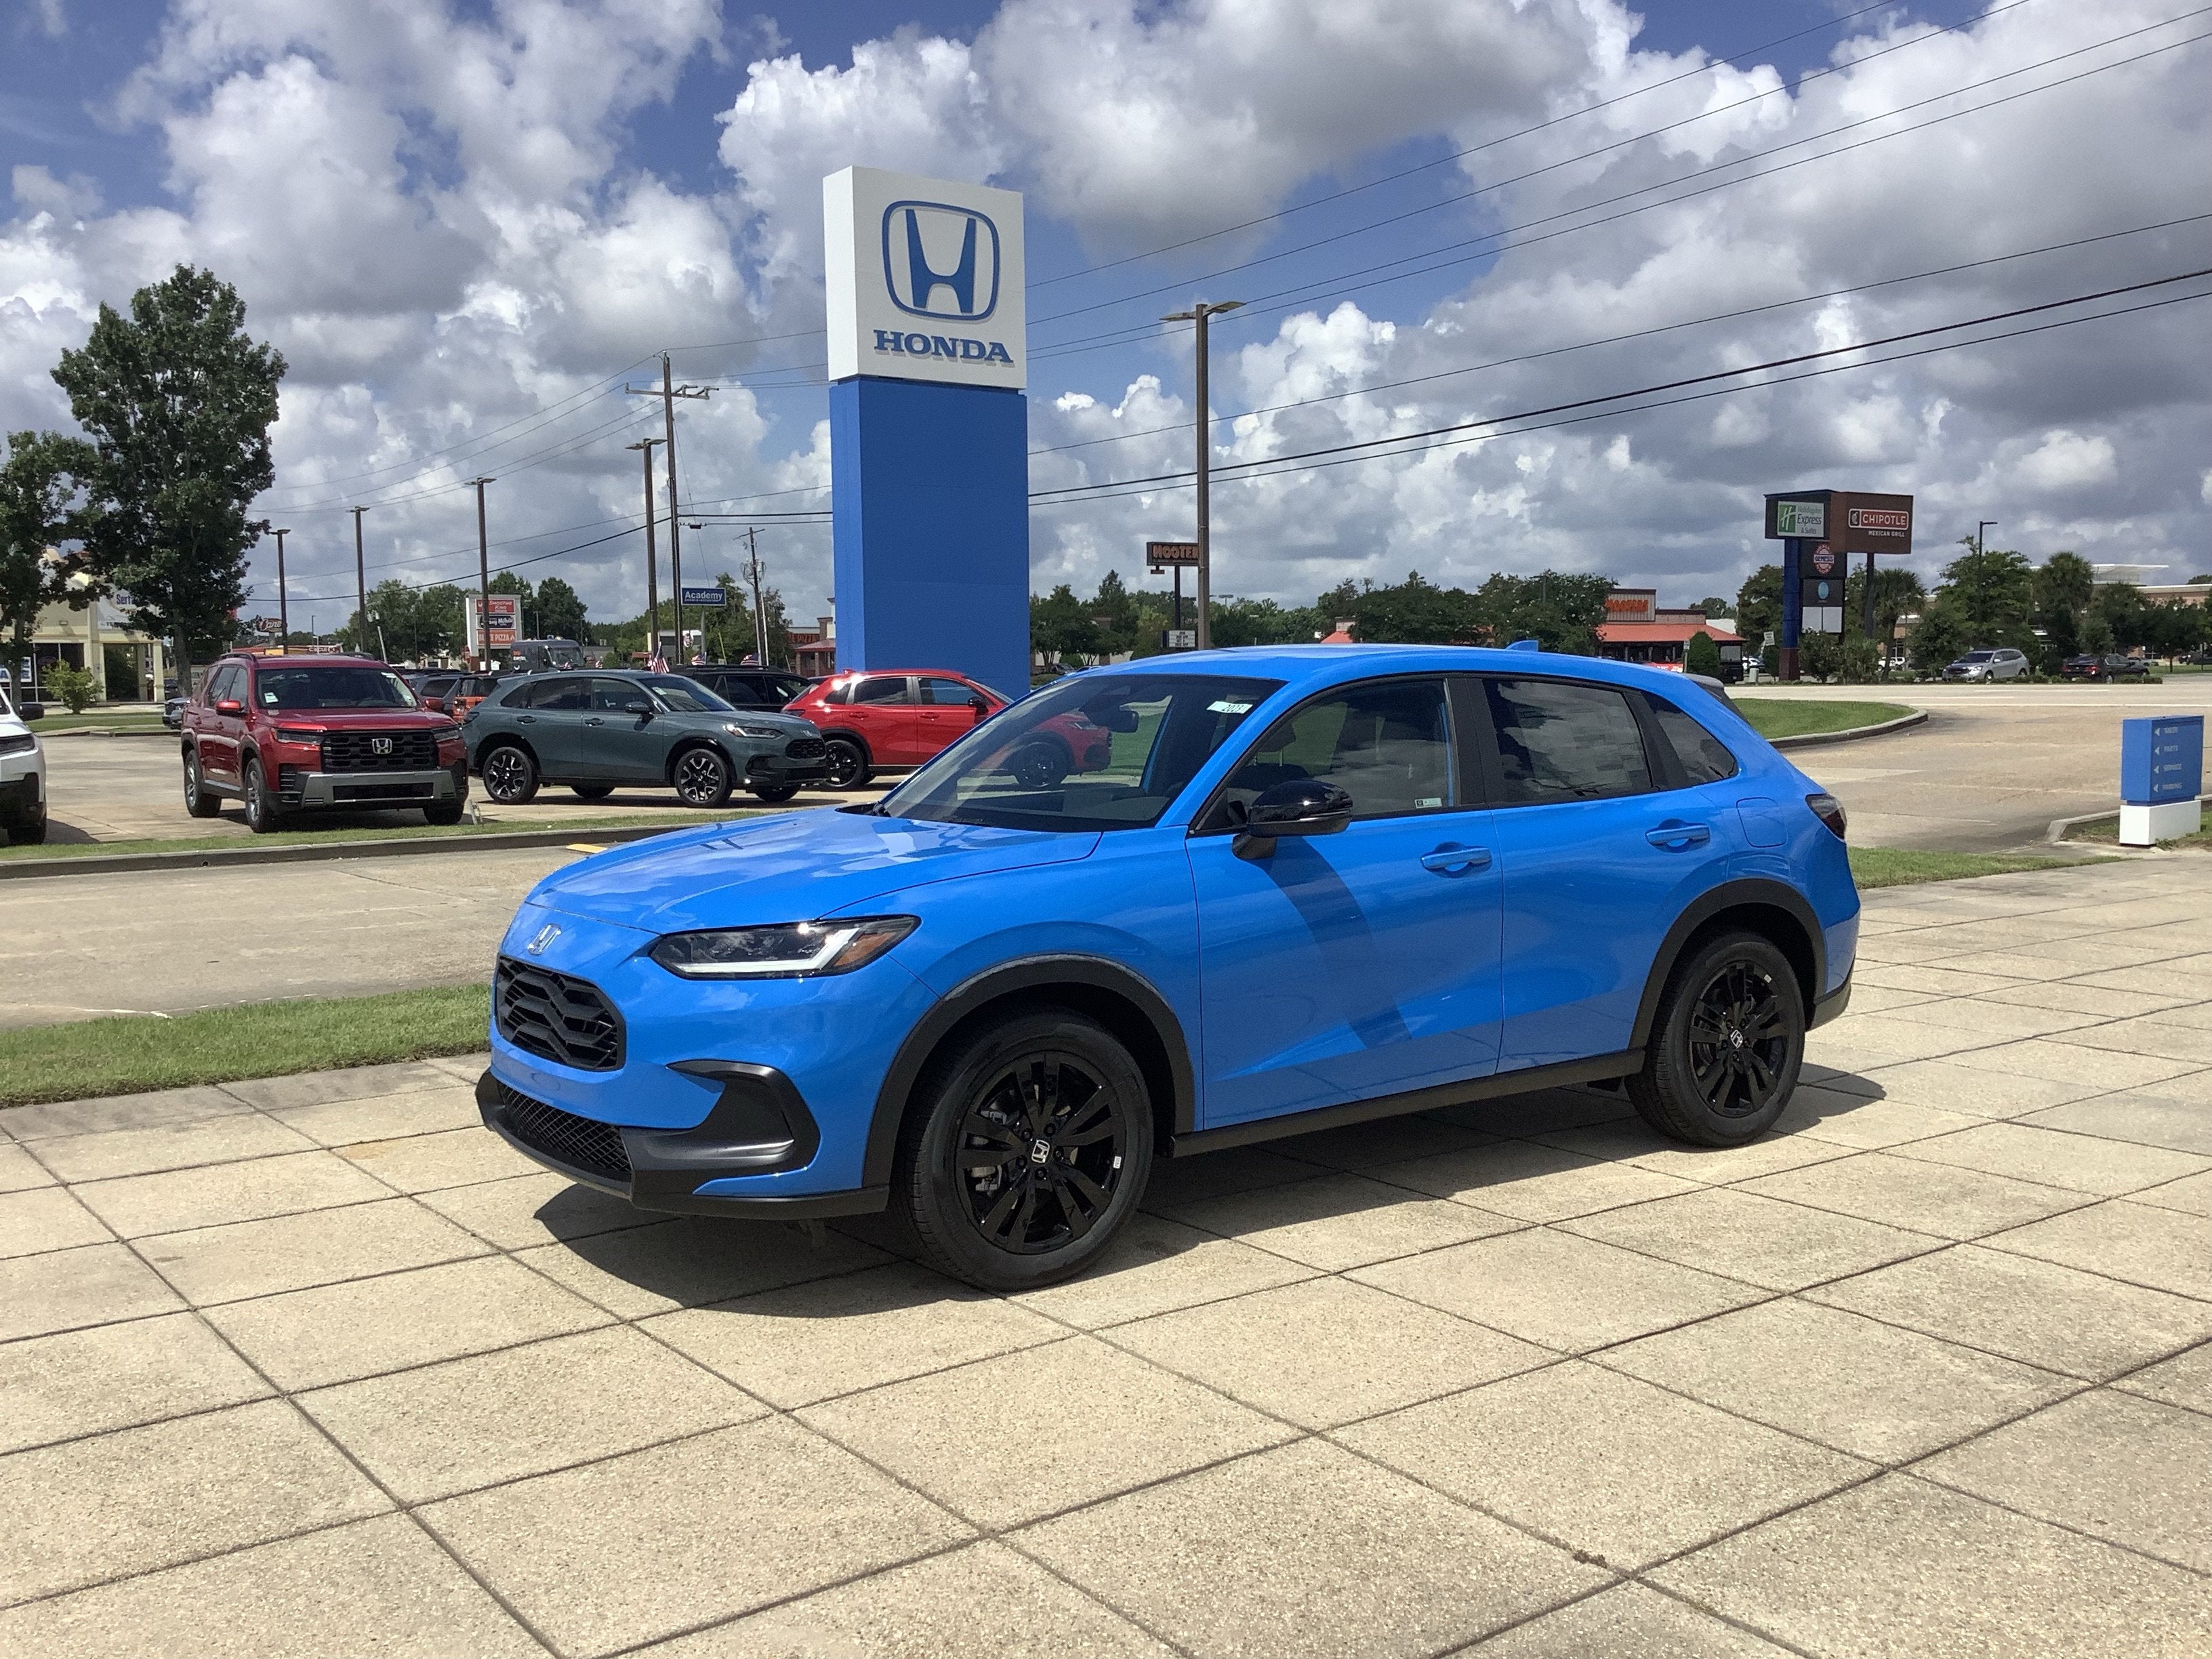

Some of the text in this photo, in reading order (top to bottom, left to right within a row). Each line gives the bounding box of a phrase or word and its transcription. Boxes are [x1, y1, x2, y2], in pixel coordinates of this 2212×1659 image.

[874, 329, 1014, 363] HONDA
[1797, 514, 1822, 527] Express
[1862, 514, 1906, 526] CHIPOTLE
[1153, 544, 1199, 559] HOOTER
[684, 591, 722, 602] Academy
[1222, 704, 1244, 712] 2023
